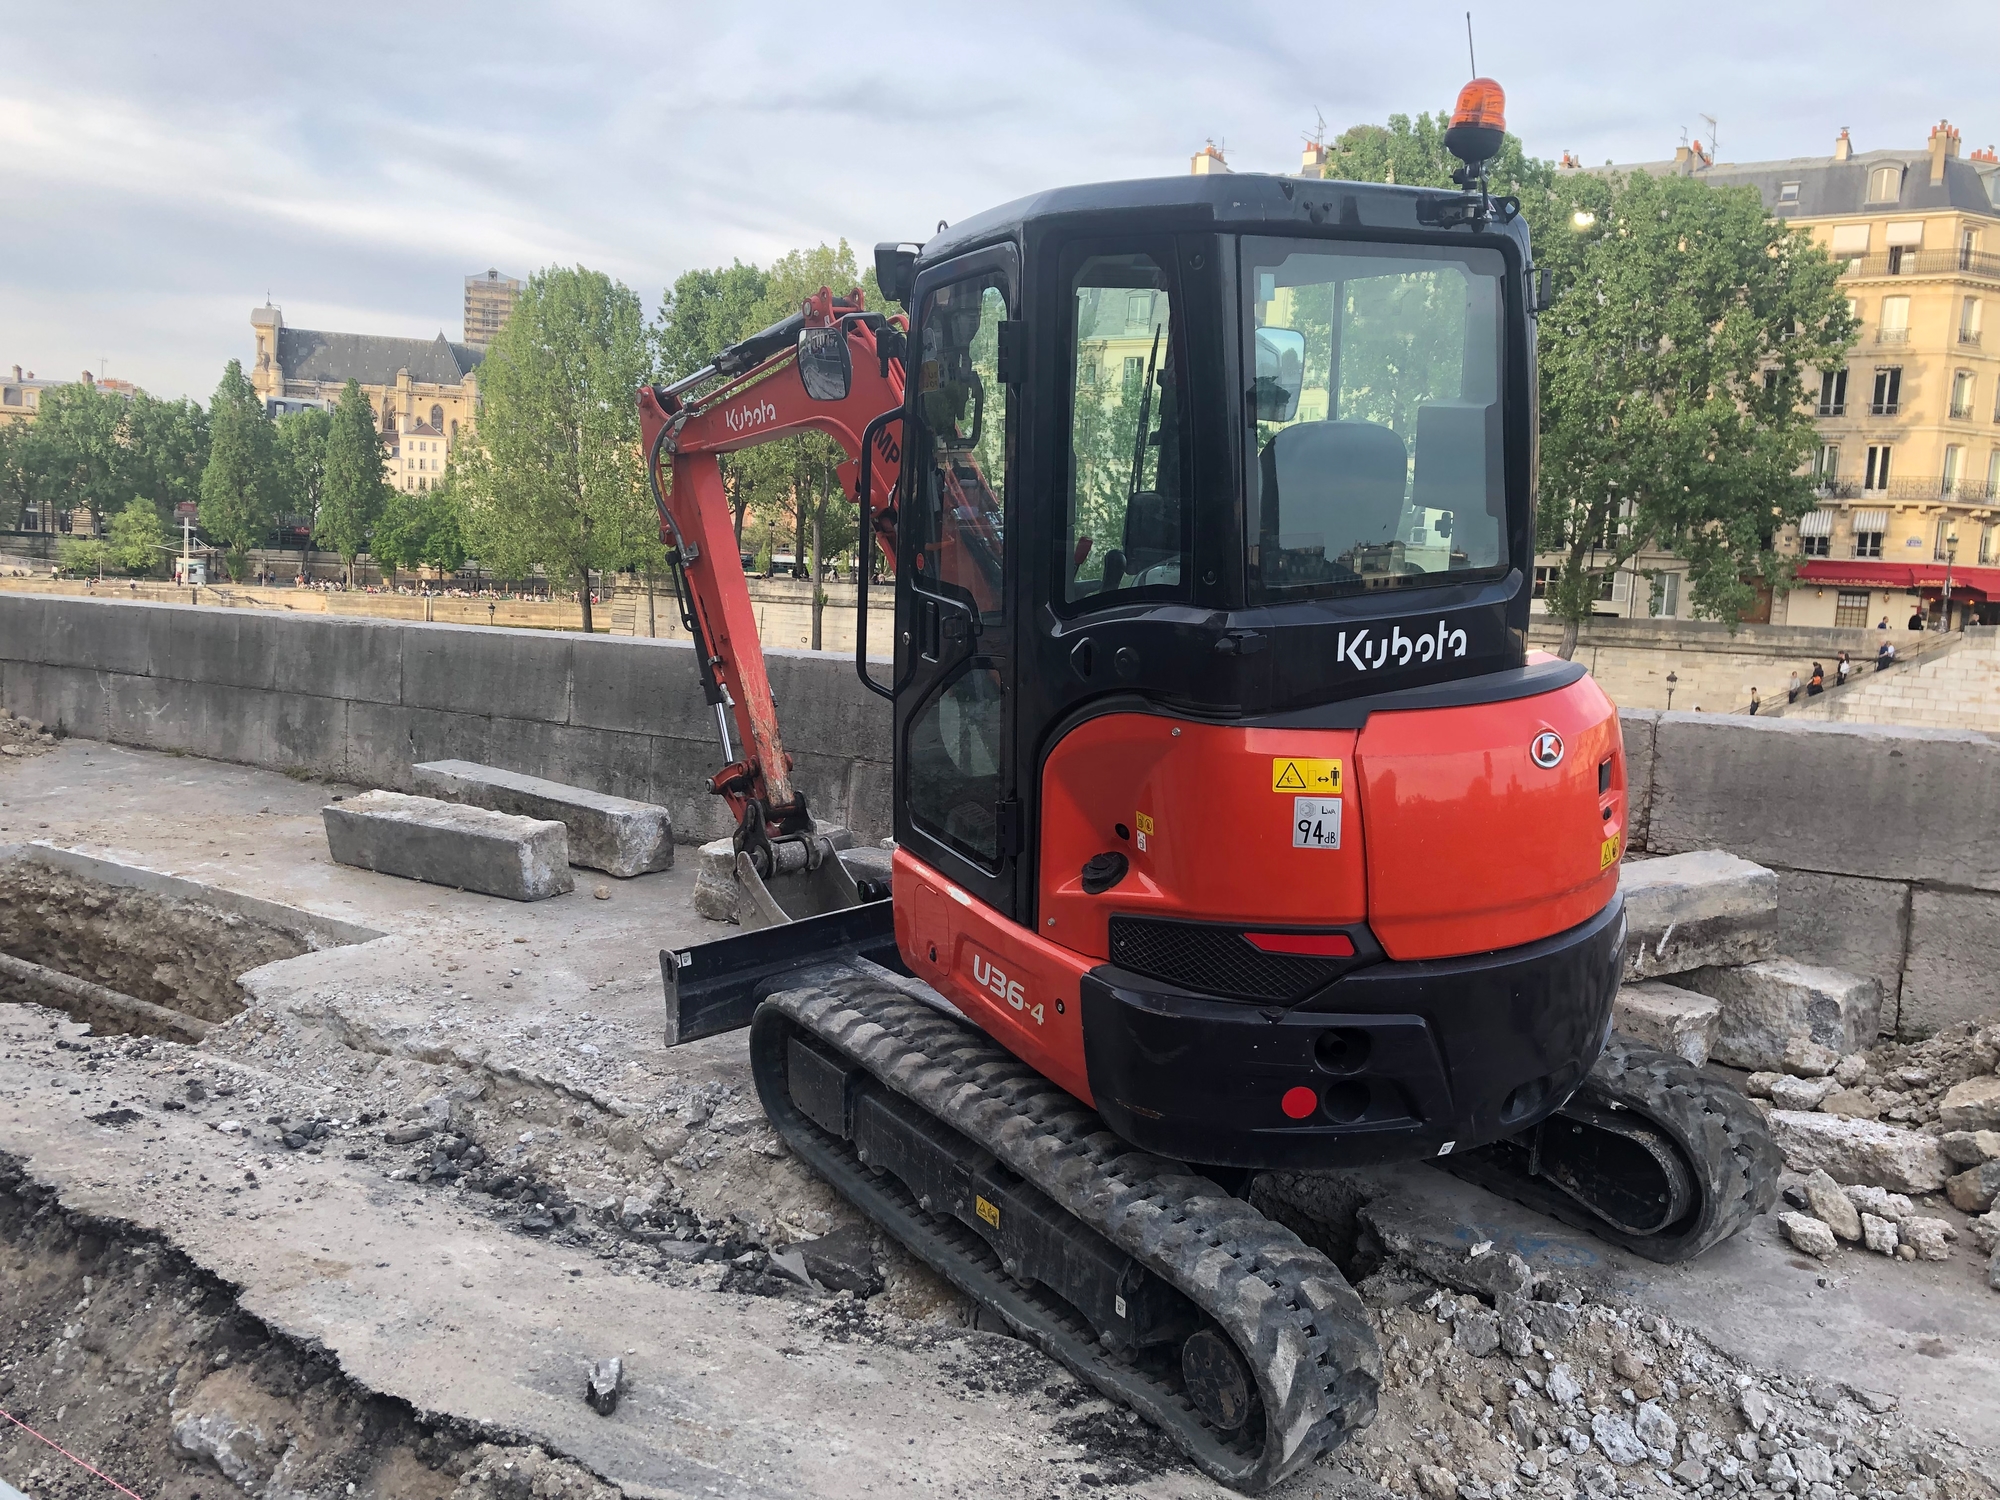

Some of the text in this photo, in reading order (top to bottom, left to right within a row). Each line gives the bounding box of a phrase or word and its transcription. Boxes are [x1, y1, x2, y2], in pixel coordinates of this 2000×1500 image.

[725, 399, 776, 432] Kubota
[1336, 620, 1467, 671] Kubota
[973, 954, 1045, 1026] U36-4
